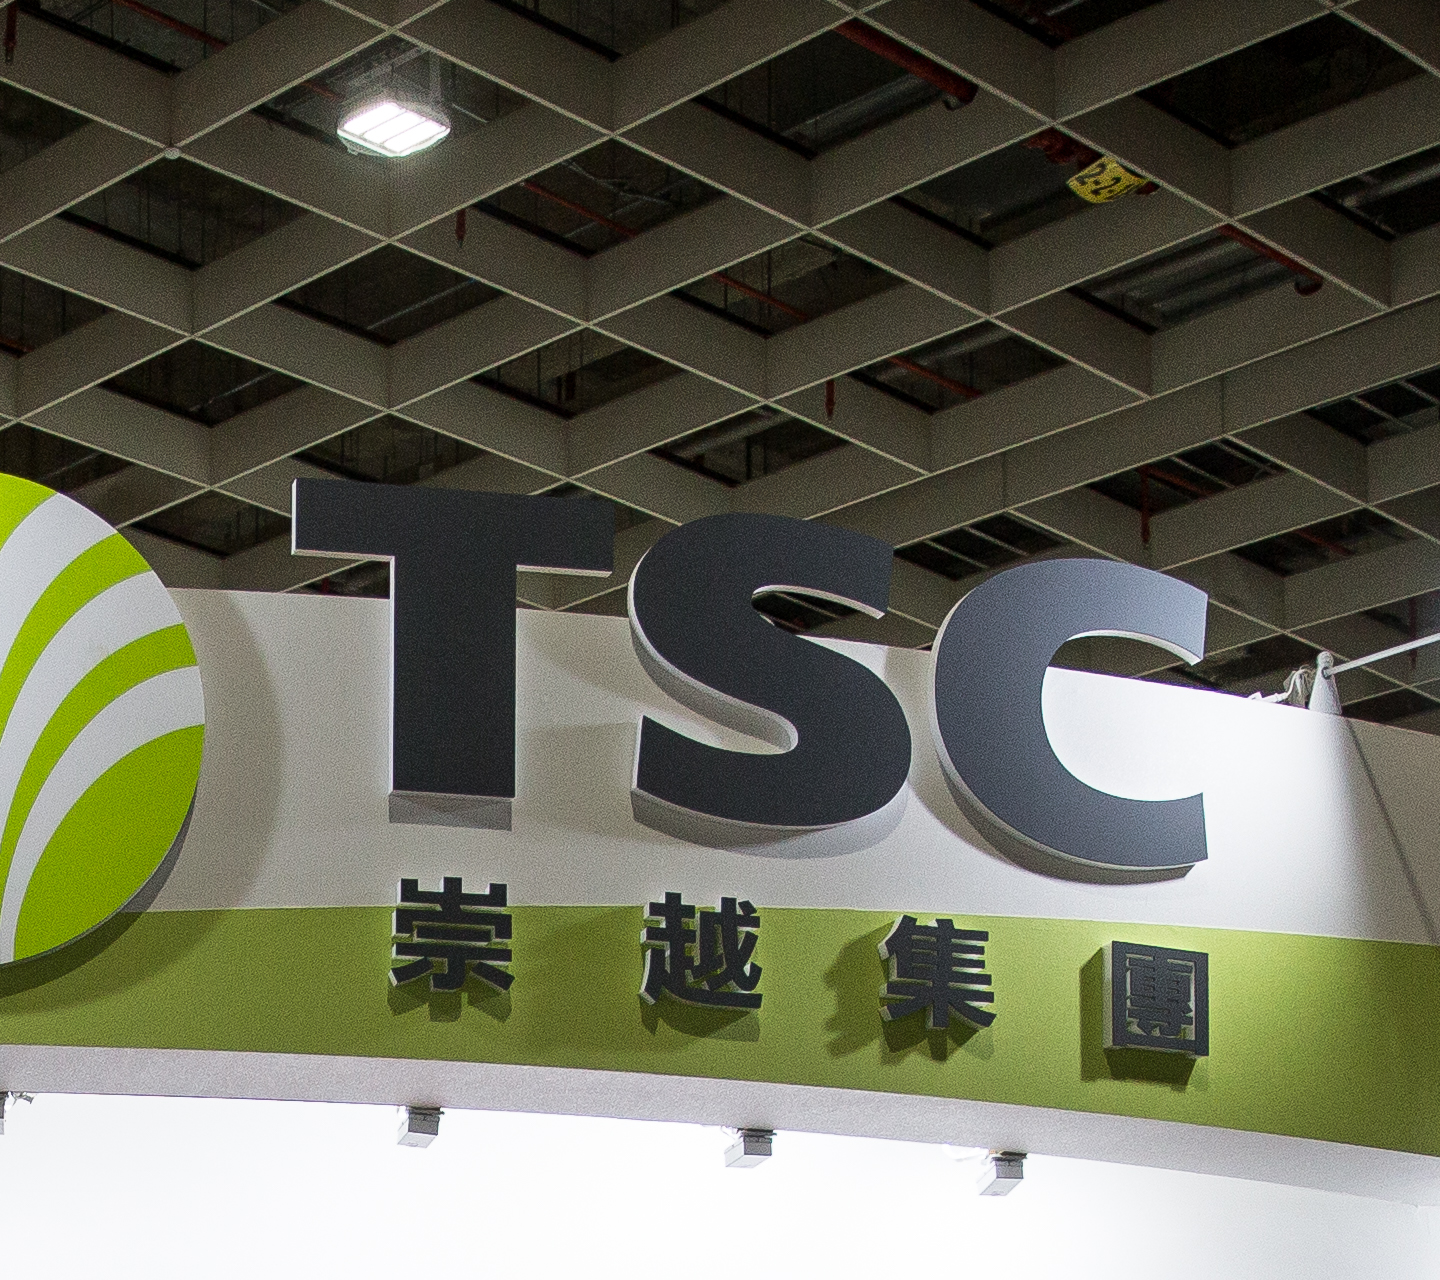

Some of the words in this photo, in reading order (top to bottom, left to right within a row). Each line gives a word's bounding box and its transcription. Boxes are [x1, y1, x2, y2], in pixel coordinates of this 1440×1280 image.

[292, 477, 1209, 874] TSC
[390, 876, 1209, 1057] 崇越集團
